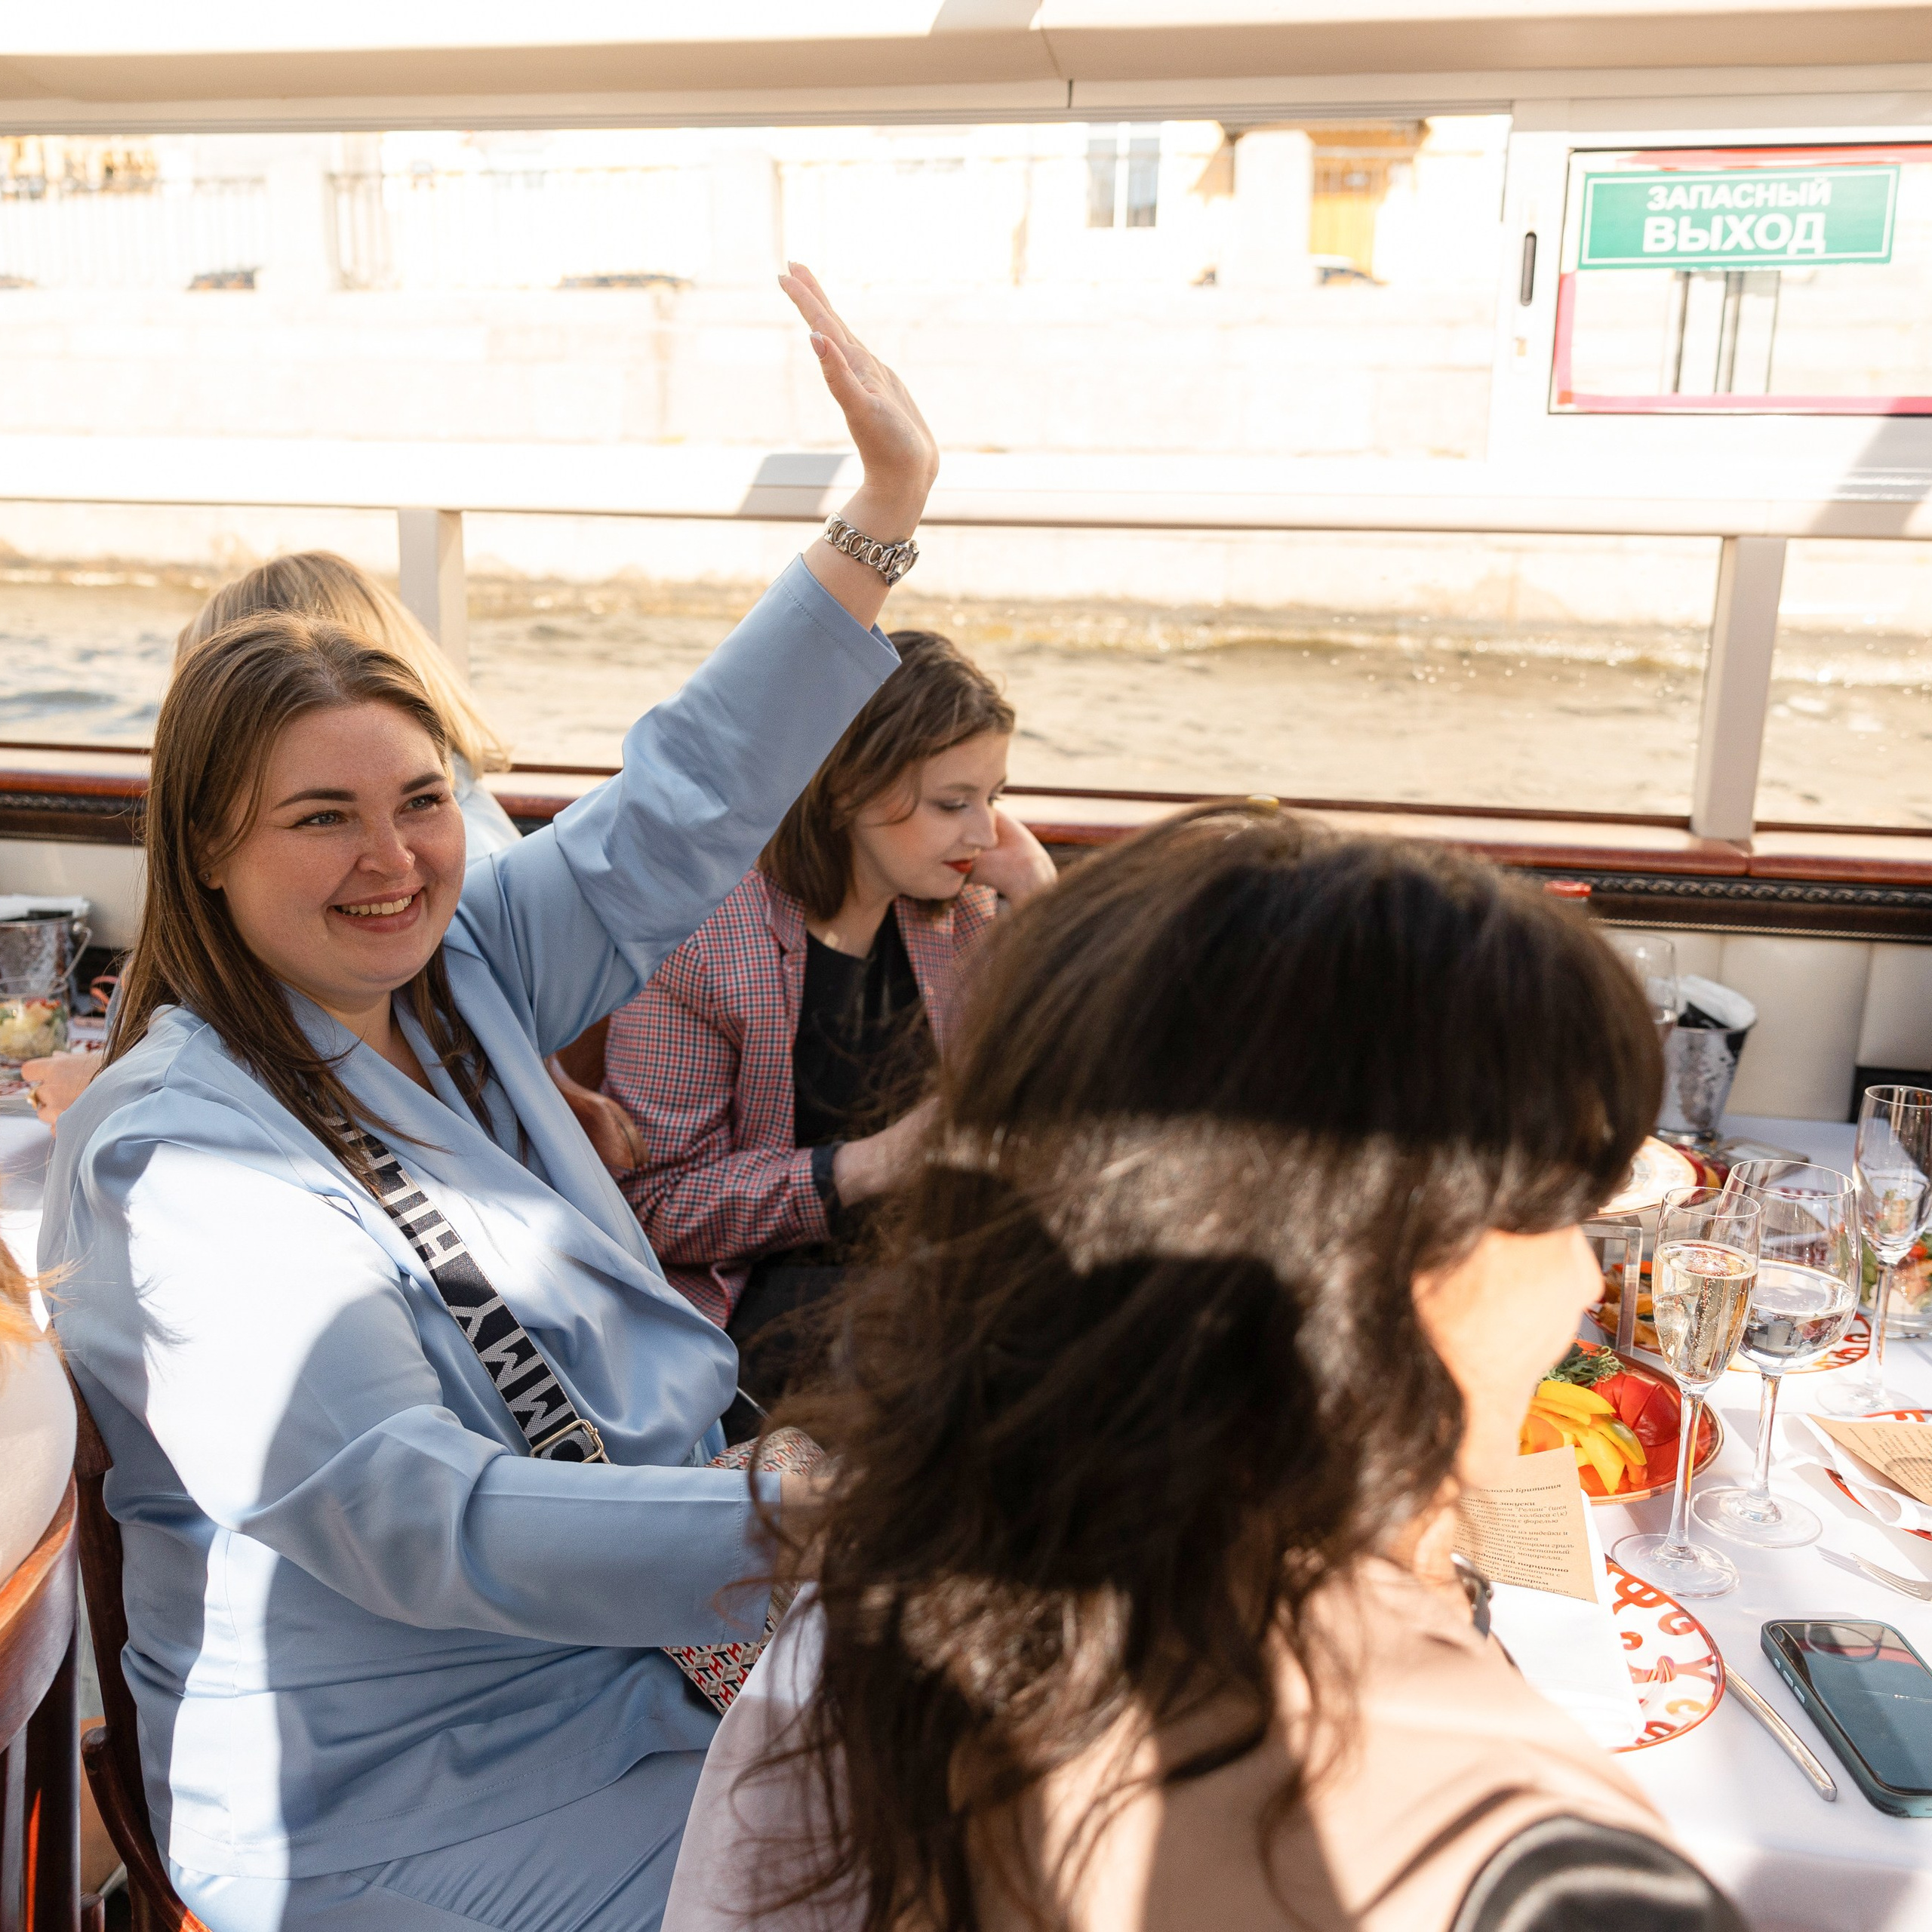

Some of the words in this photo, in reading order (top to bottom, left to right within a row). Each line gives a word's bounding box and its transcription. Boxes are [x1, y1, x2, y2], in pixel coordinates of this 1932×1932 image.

[1647, 177, 1832, 211] ЗАПАСНЫЙ
[1642, 212, 1826, 255] ВЫХОД
[450, 1296, 595, 1461] OMMY
[1460, 1497, 1497, 1505] олодные
